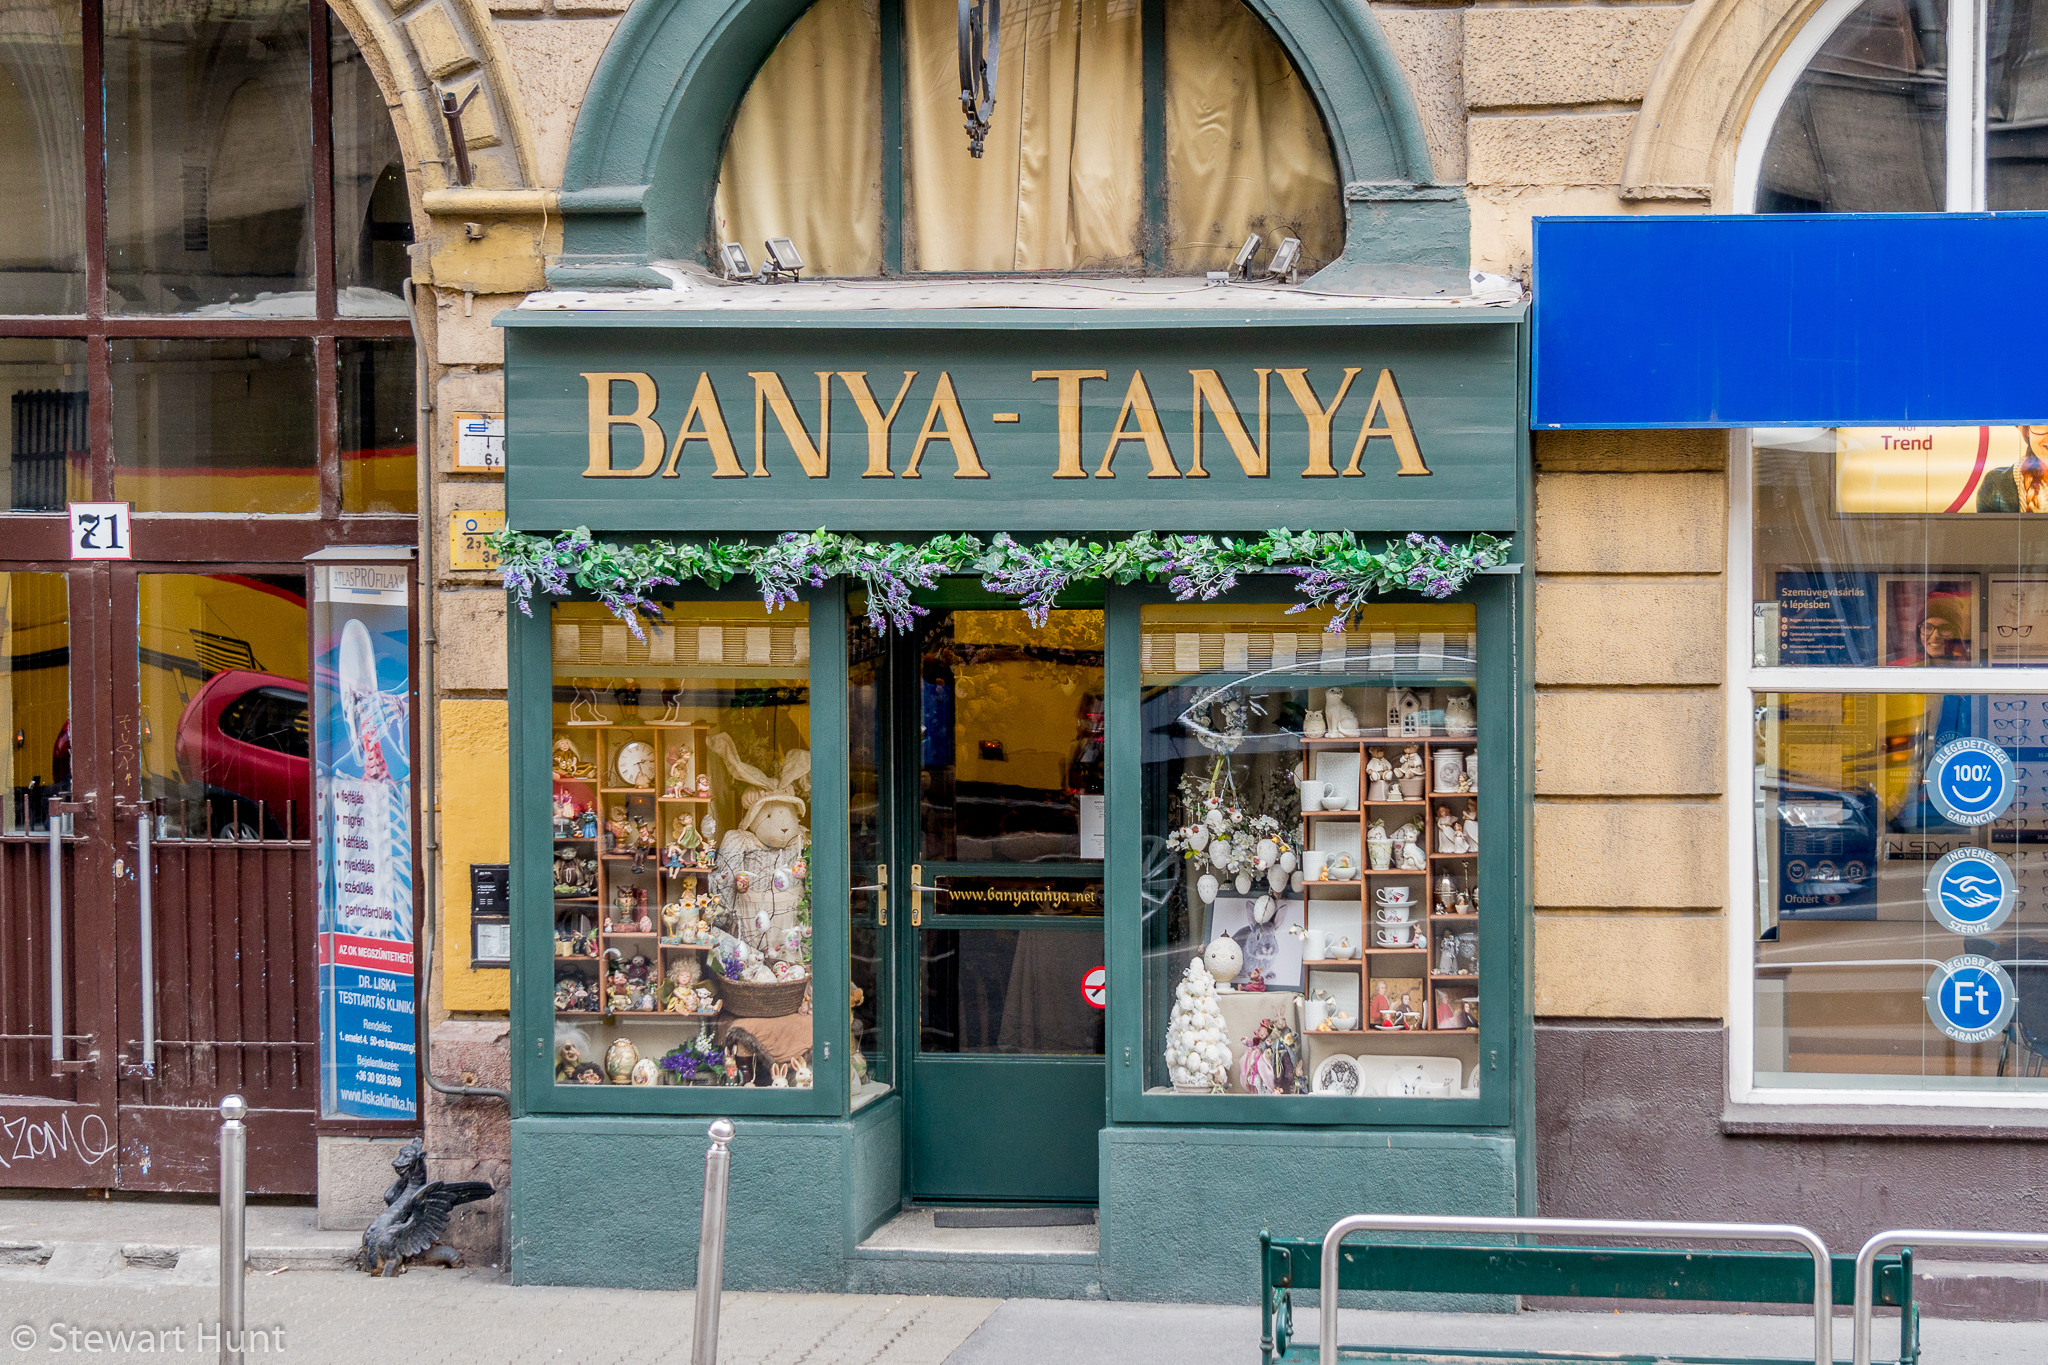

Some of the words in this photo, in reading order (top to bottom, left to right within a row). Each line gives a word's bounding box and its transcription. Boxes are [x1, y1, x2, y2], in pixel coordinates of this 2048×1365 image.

[1881, 434, 1933, 451] Trend
[78, 513, 124, 549] 71
[1781, 586, 1865, 599] Szemüvegvásárlás
[1781, 600, 1788, 609] 4
[1790, 599, 1831, 611] lépésben
[1935, 740, 2008, 765] ELÉGEDETTSÉGI
[1953, 764, 1992, 782] 100%
[341, 789, 365, 805] fejfájás
[342, 814, 365, 829] migrén
[1946, 809, 1997, 825] GARANCIA
[342, 835, 369, 852] hátfájás
[1946, 848, 1998, 864] INGYENES
[344, 859, 375, 876] nyakfájás
[1784, 893, 1820, 904] Ofotért
[1948, 920, 1991, 934] SZERVIZ
[338, 944, 348, 955] AZ
[348, 946, 358, 956] OK
[358, 974, 373, 989] DR.
[373, 977, 397, 993] LISKA
[338, 990, 386, 1010] TESTTARTÁS
[1954, 981, 1989, 1015] Ft
[363, 1018, 393, 1033] Rendelés:
[1945, 1026, 1996, 1042] GARANCIA
[355, 1069, 367, 1082] +36
[367, 1071, 375, 1083] 30
[340, 1088, 417, 1113] www.liskaklinika.hu
